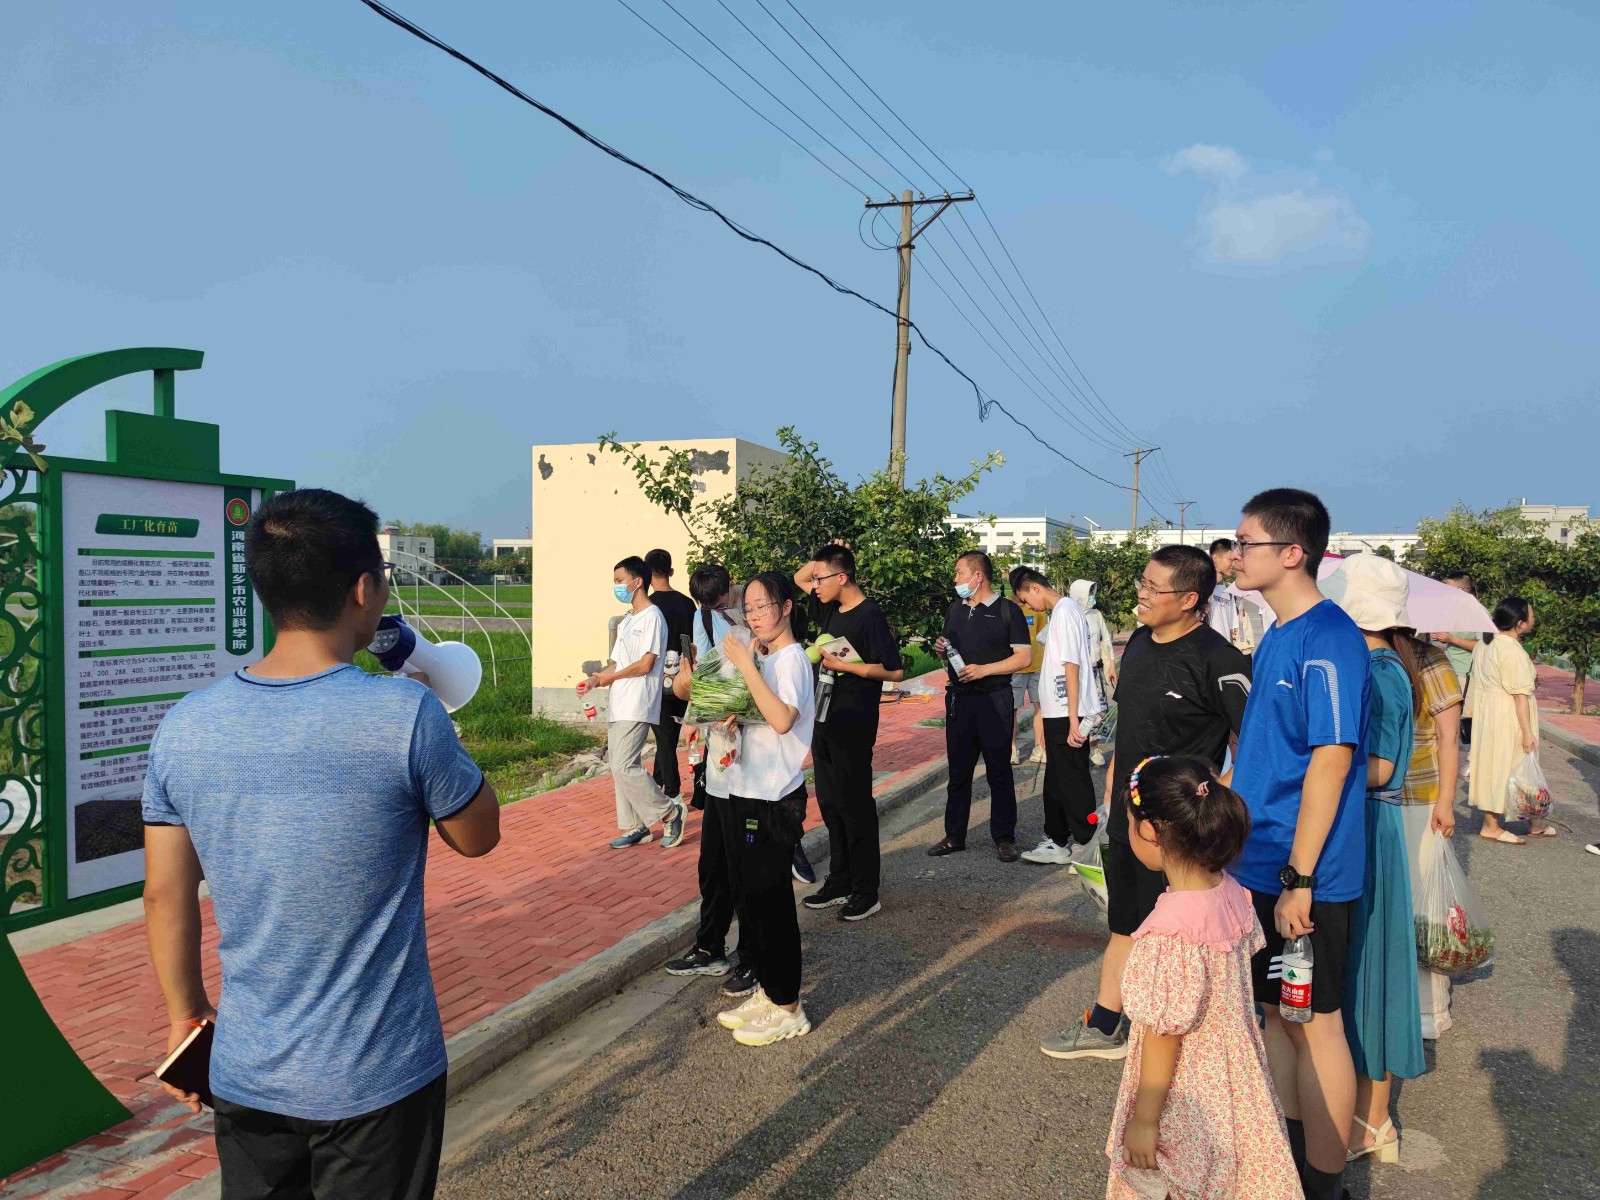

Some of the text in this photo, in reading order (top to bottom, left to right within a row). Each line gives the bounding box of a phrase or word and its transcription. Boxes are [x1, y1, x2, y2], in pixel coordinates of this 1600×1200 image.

[120, 519, 178, 533] 工厂化育苗
[232, 531, 247, 650] 河南省新乡市农业科学院
